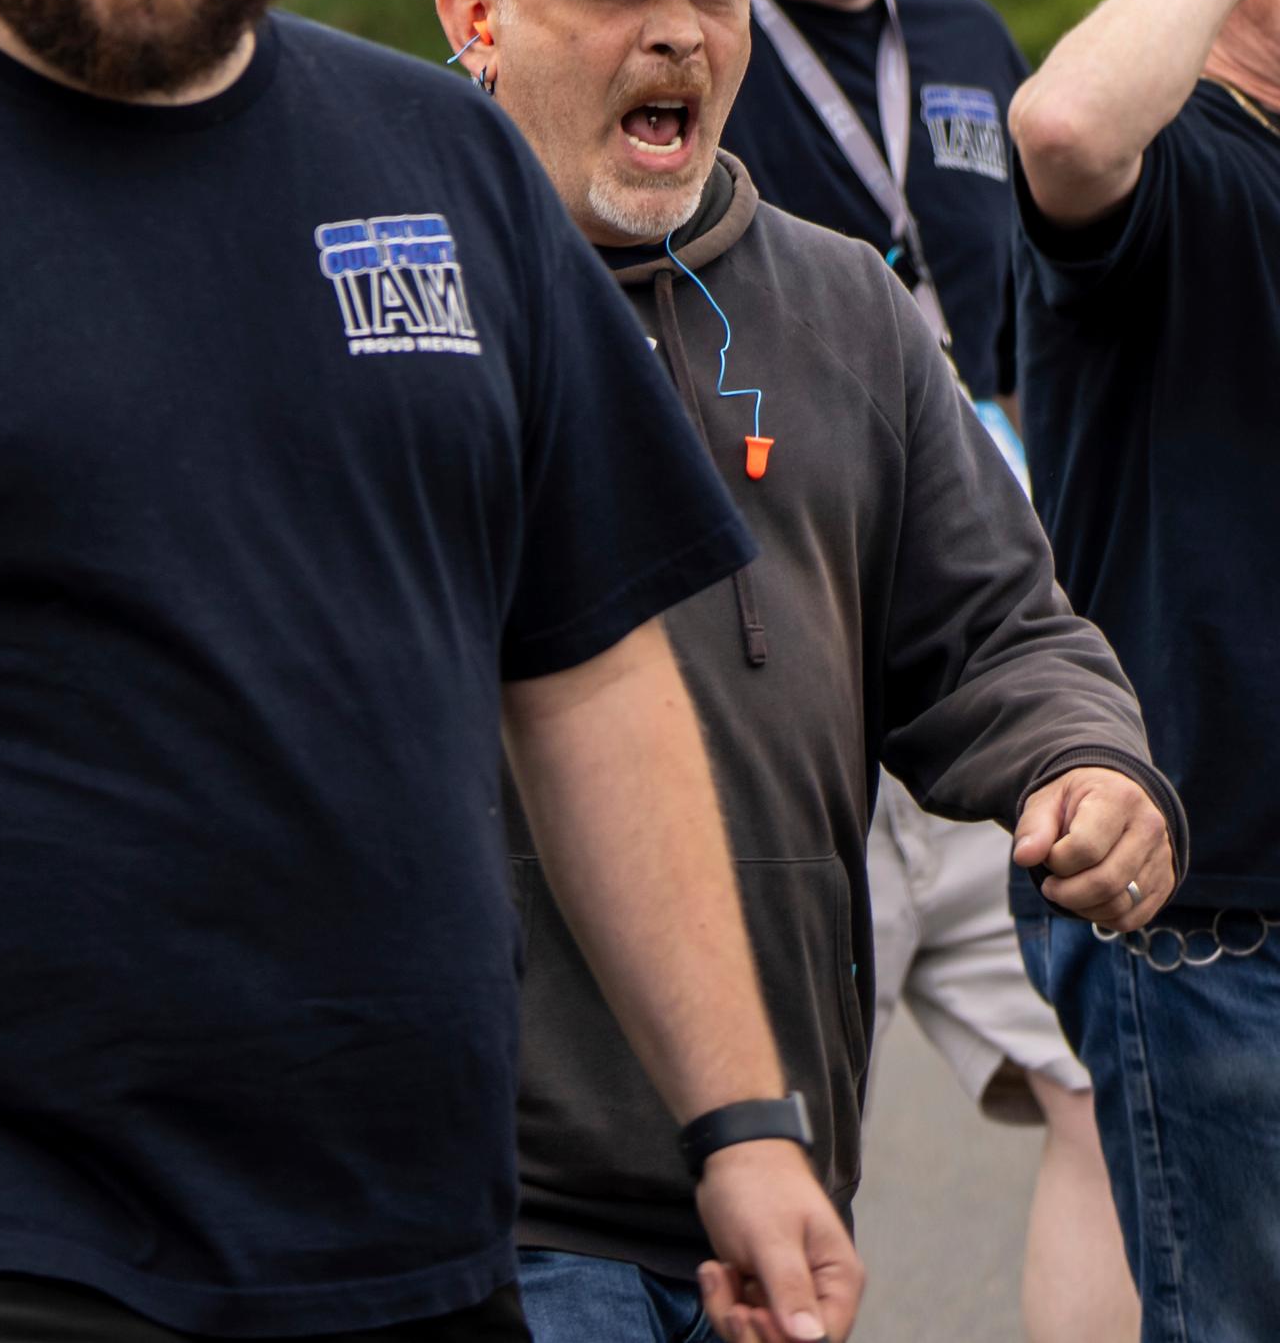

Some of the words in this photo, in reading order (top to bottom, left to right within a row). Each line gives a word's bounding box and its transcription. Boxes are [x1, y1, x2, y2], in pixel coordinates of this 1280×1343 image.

[326, 245, 382, 275] OUR
[333, 264, 478, 338] IAM
[348, 336, 416, 356] PROUD
[416, 336, 482, 356] MEMBER
